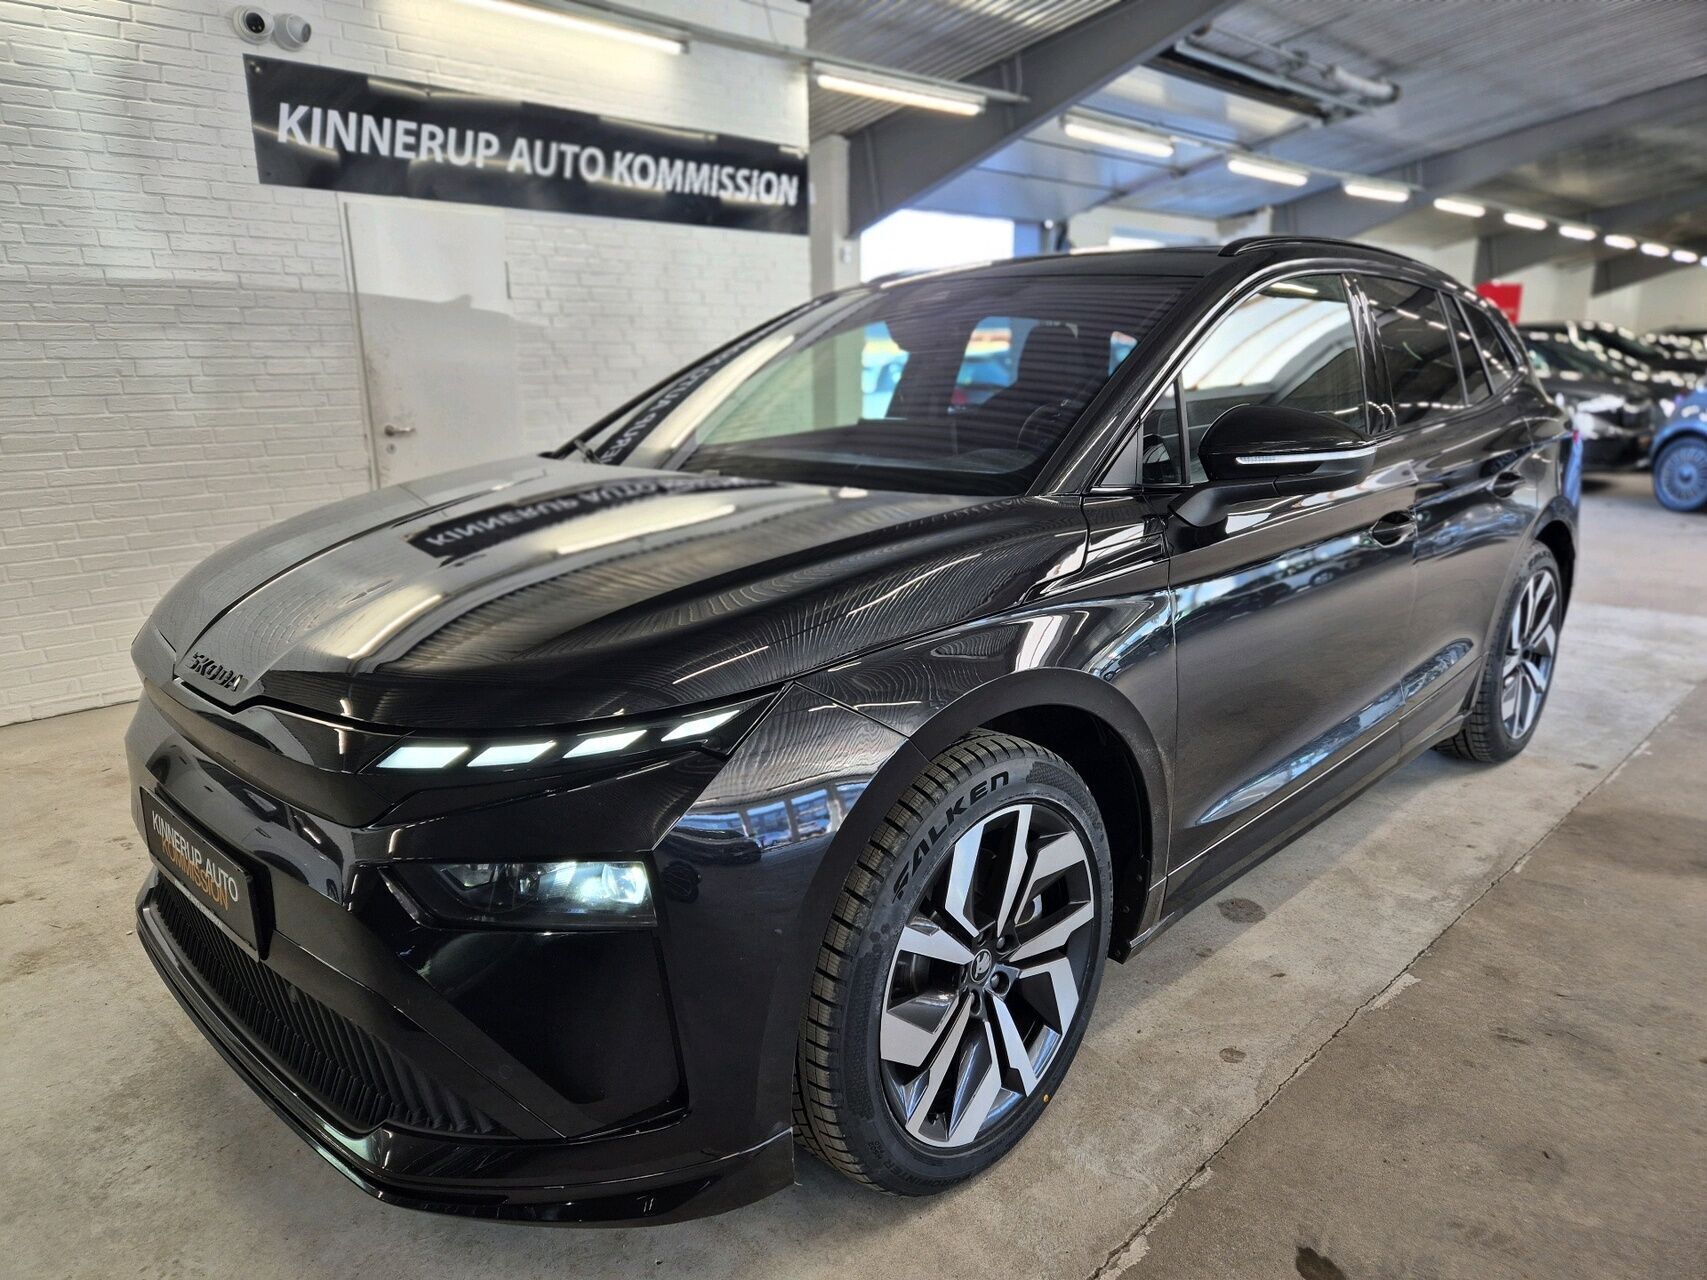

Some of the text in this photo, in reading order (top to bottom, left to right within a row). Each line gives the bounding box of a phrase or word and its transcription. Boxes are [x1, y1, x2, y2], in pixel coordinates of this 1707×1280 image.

[277, 101, 799, 206] KINNERUP AUTO KOMMISSION
[152, 810, 239, 902] KINNERUP AUTO
[162, 837, 230, 911] KOMMISSION
[892, 770, 1009, 904] FALKEN
